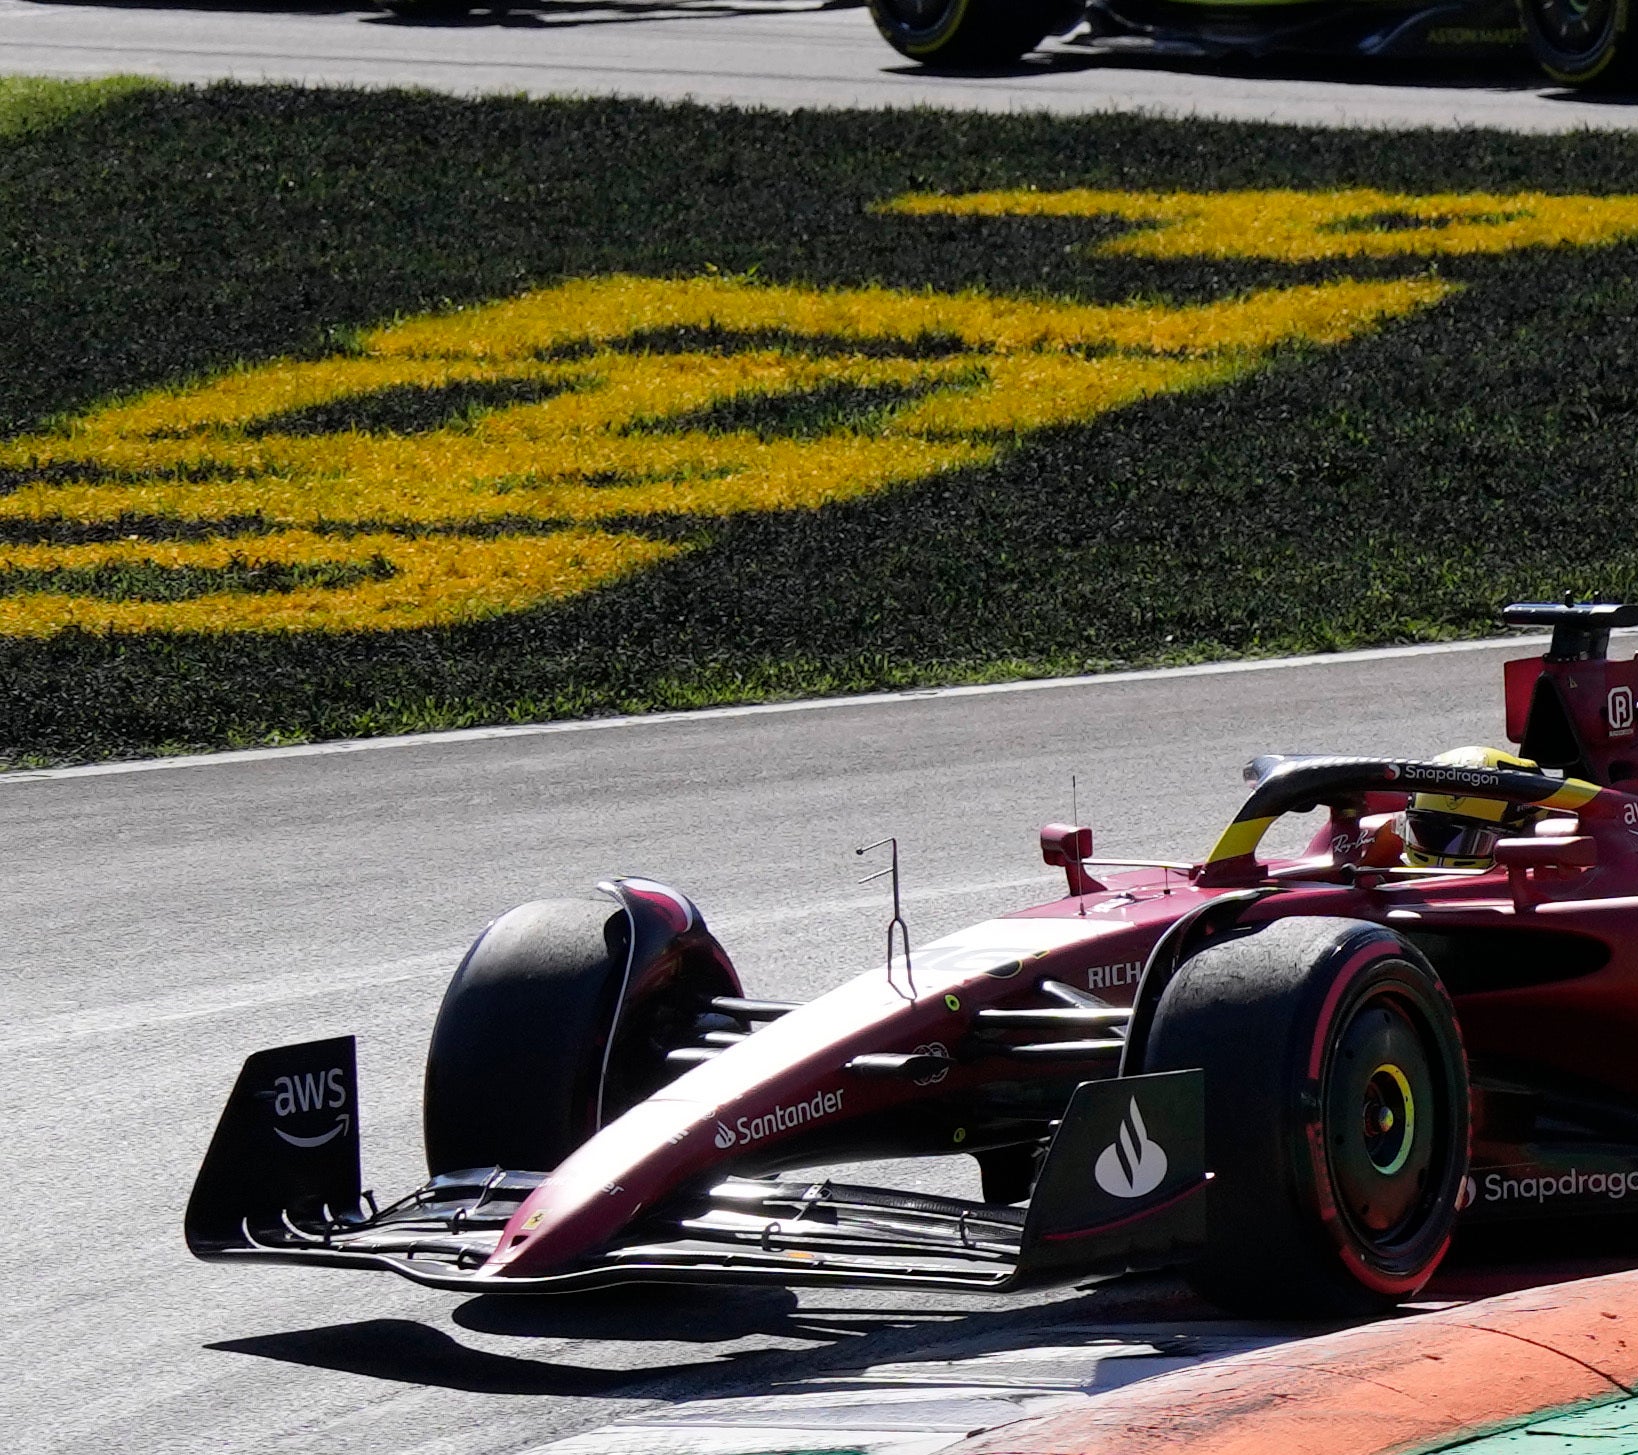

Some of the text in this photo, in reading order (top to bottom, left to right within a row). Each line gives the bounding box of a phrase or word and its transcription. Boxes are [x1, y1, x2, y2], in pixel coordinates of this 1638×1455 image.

[1404, 764, 1500, 787] Snapdragon
[1088, 960, 1142, 990] RICH
[273, 1067, 347, 1117] aws
[736, 1087, 845, 1145] Santander
